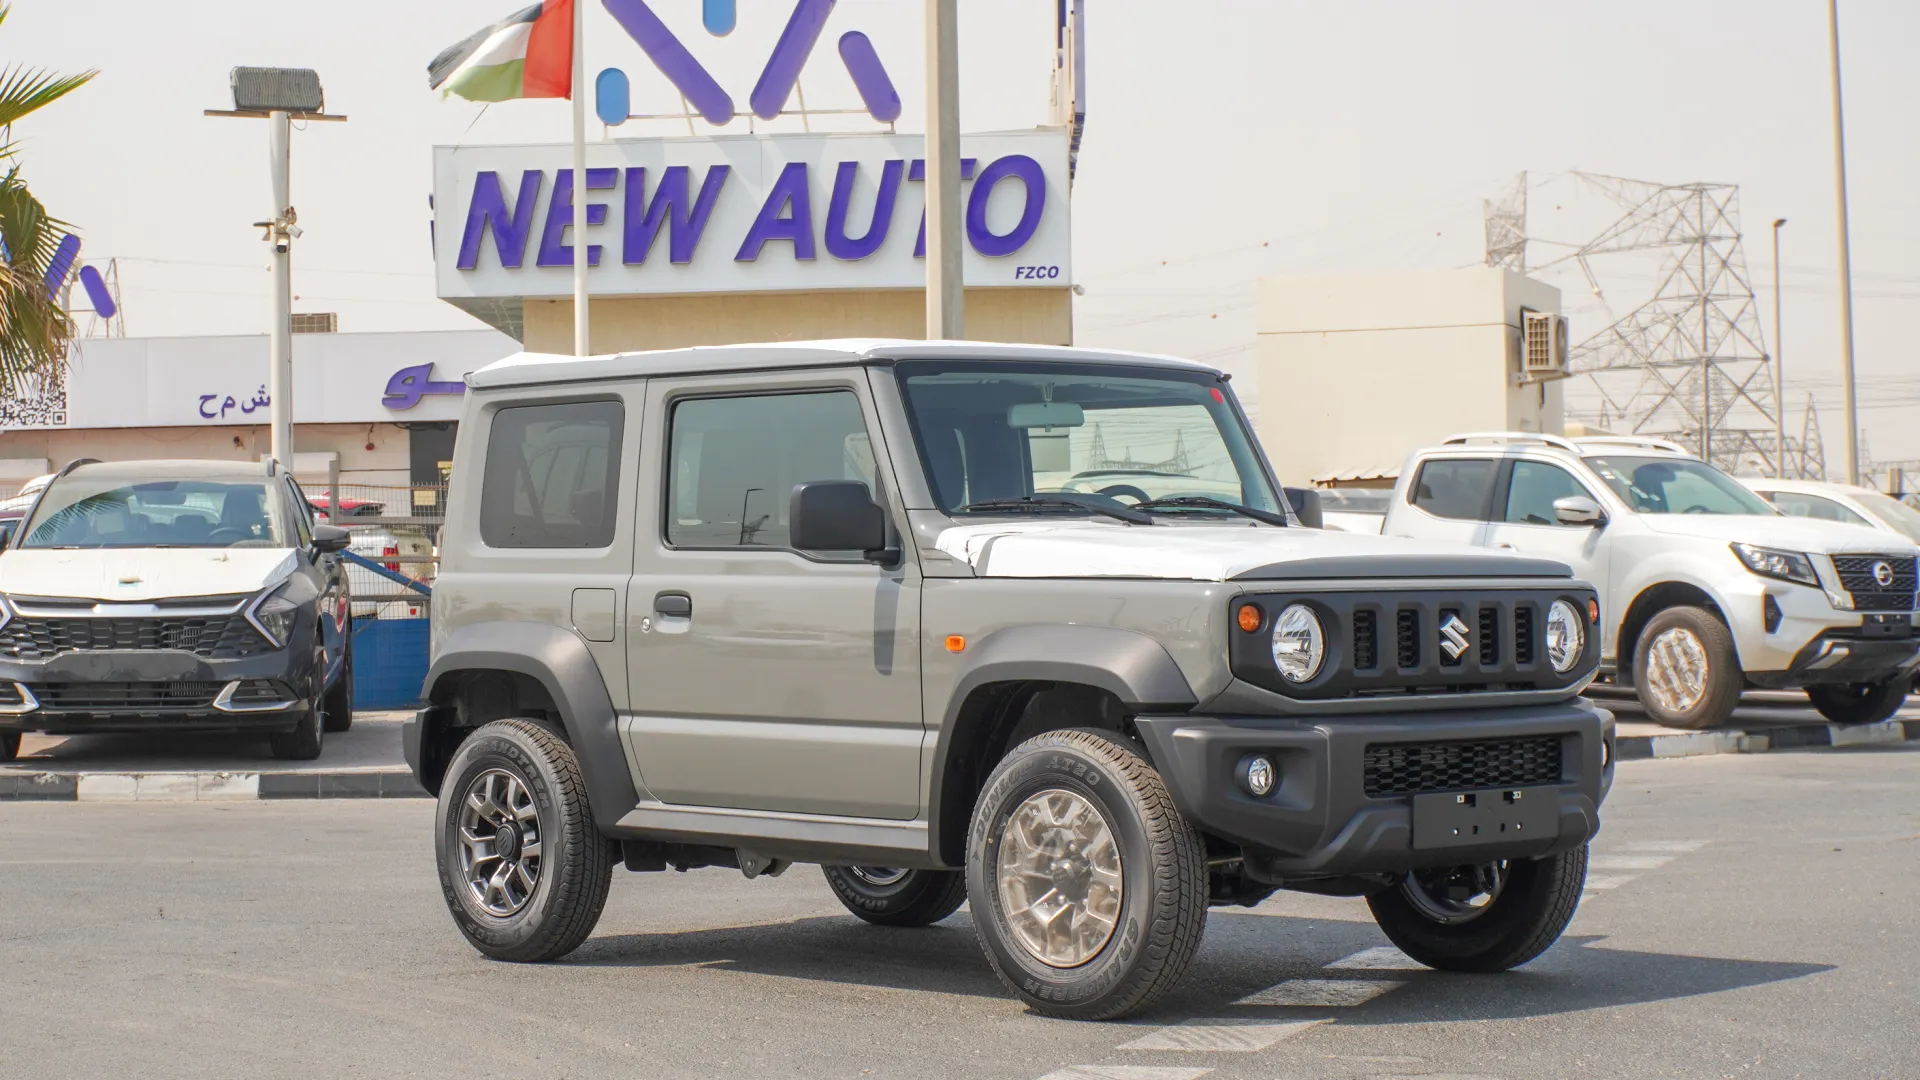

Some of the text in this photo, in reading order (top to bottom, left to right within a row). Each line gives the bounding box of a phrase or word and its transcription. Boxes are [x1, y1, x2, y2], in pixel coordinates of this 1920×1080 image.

[456, 164, 731, 271] NEW
[1014, 264, 1060, 280] FZCO
[1044, 755, 1101, 786] AT20
